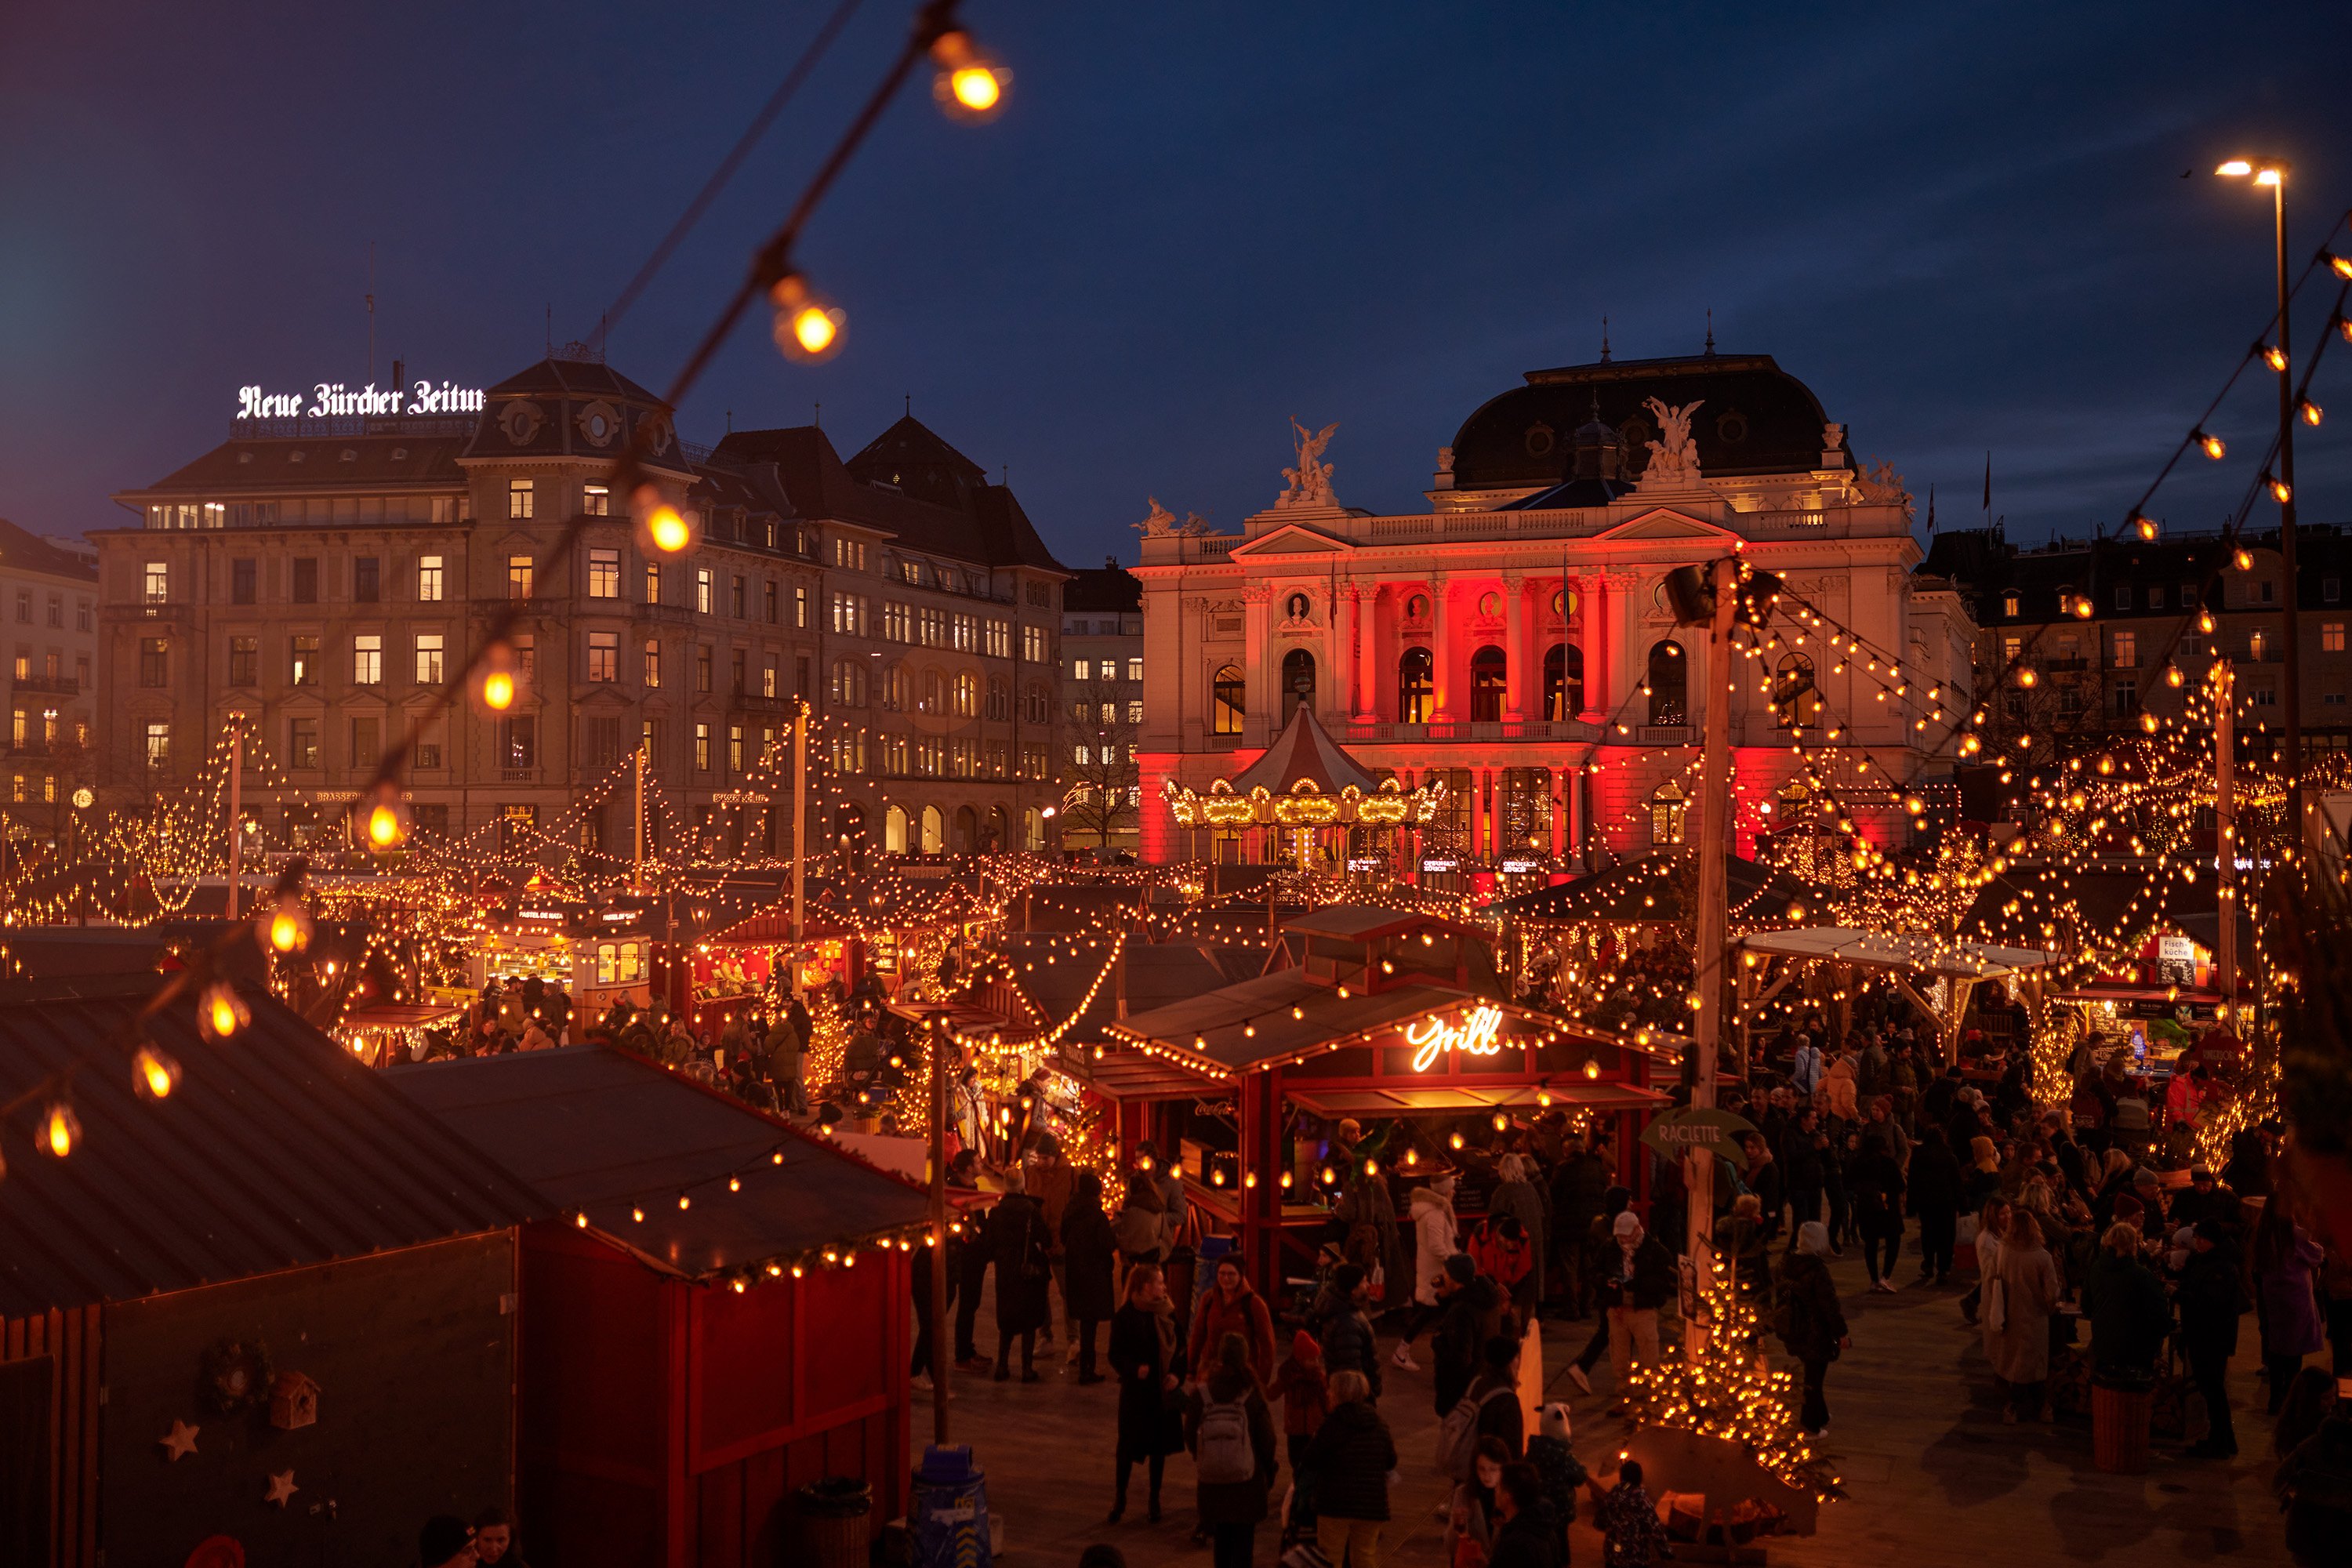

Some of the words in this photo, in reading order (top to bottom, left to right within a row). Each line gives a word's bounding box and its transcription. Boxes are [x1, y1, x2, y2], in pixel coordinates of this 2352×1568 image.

[237, 384, 303, 419] Neue
[307, 382, 405, 418] Zürcher
[407, 380, 486, 416] Zeitun
[1658, 1124, 1722, 1143] RACLETTE
